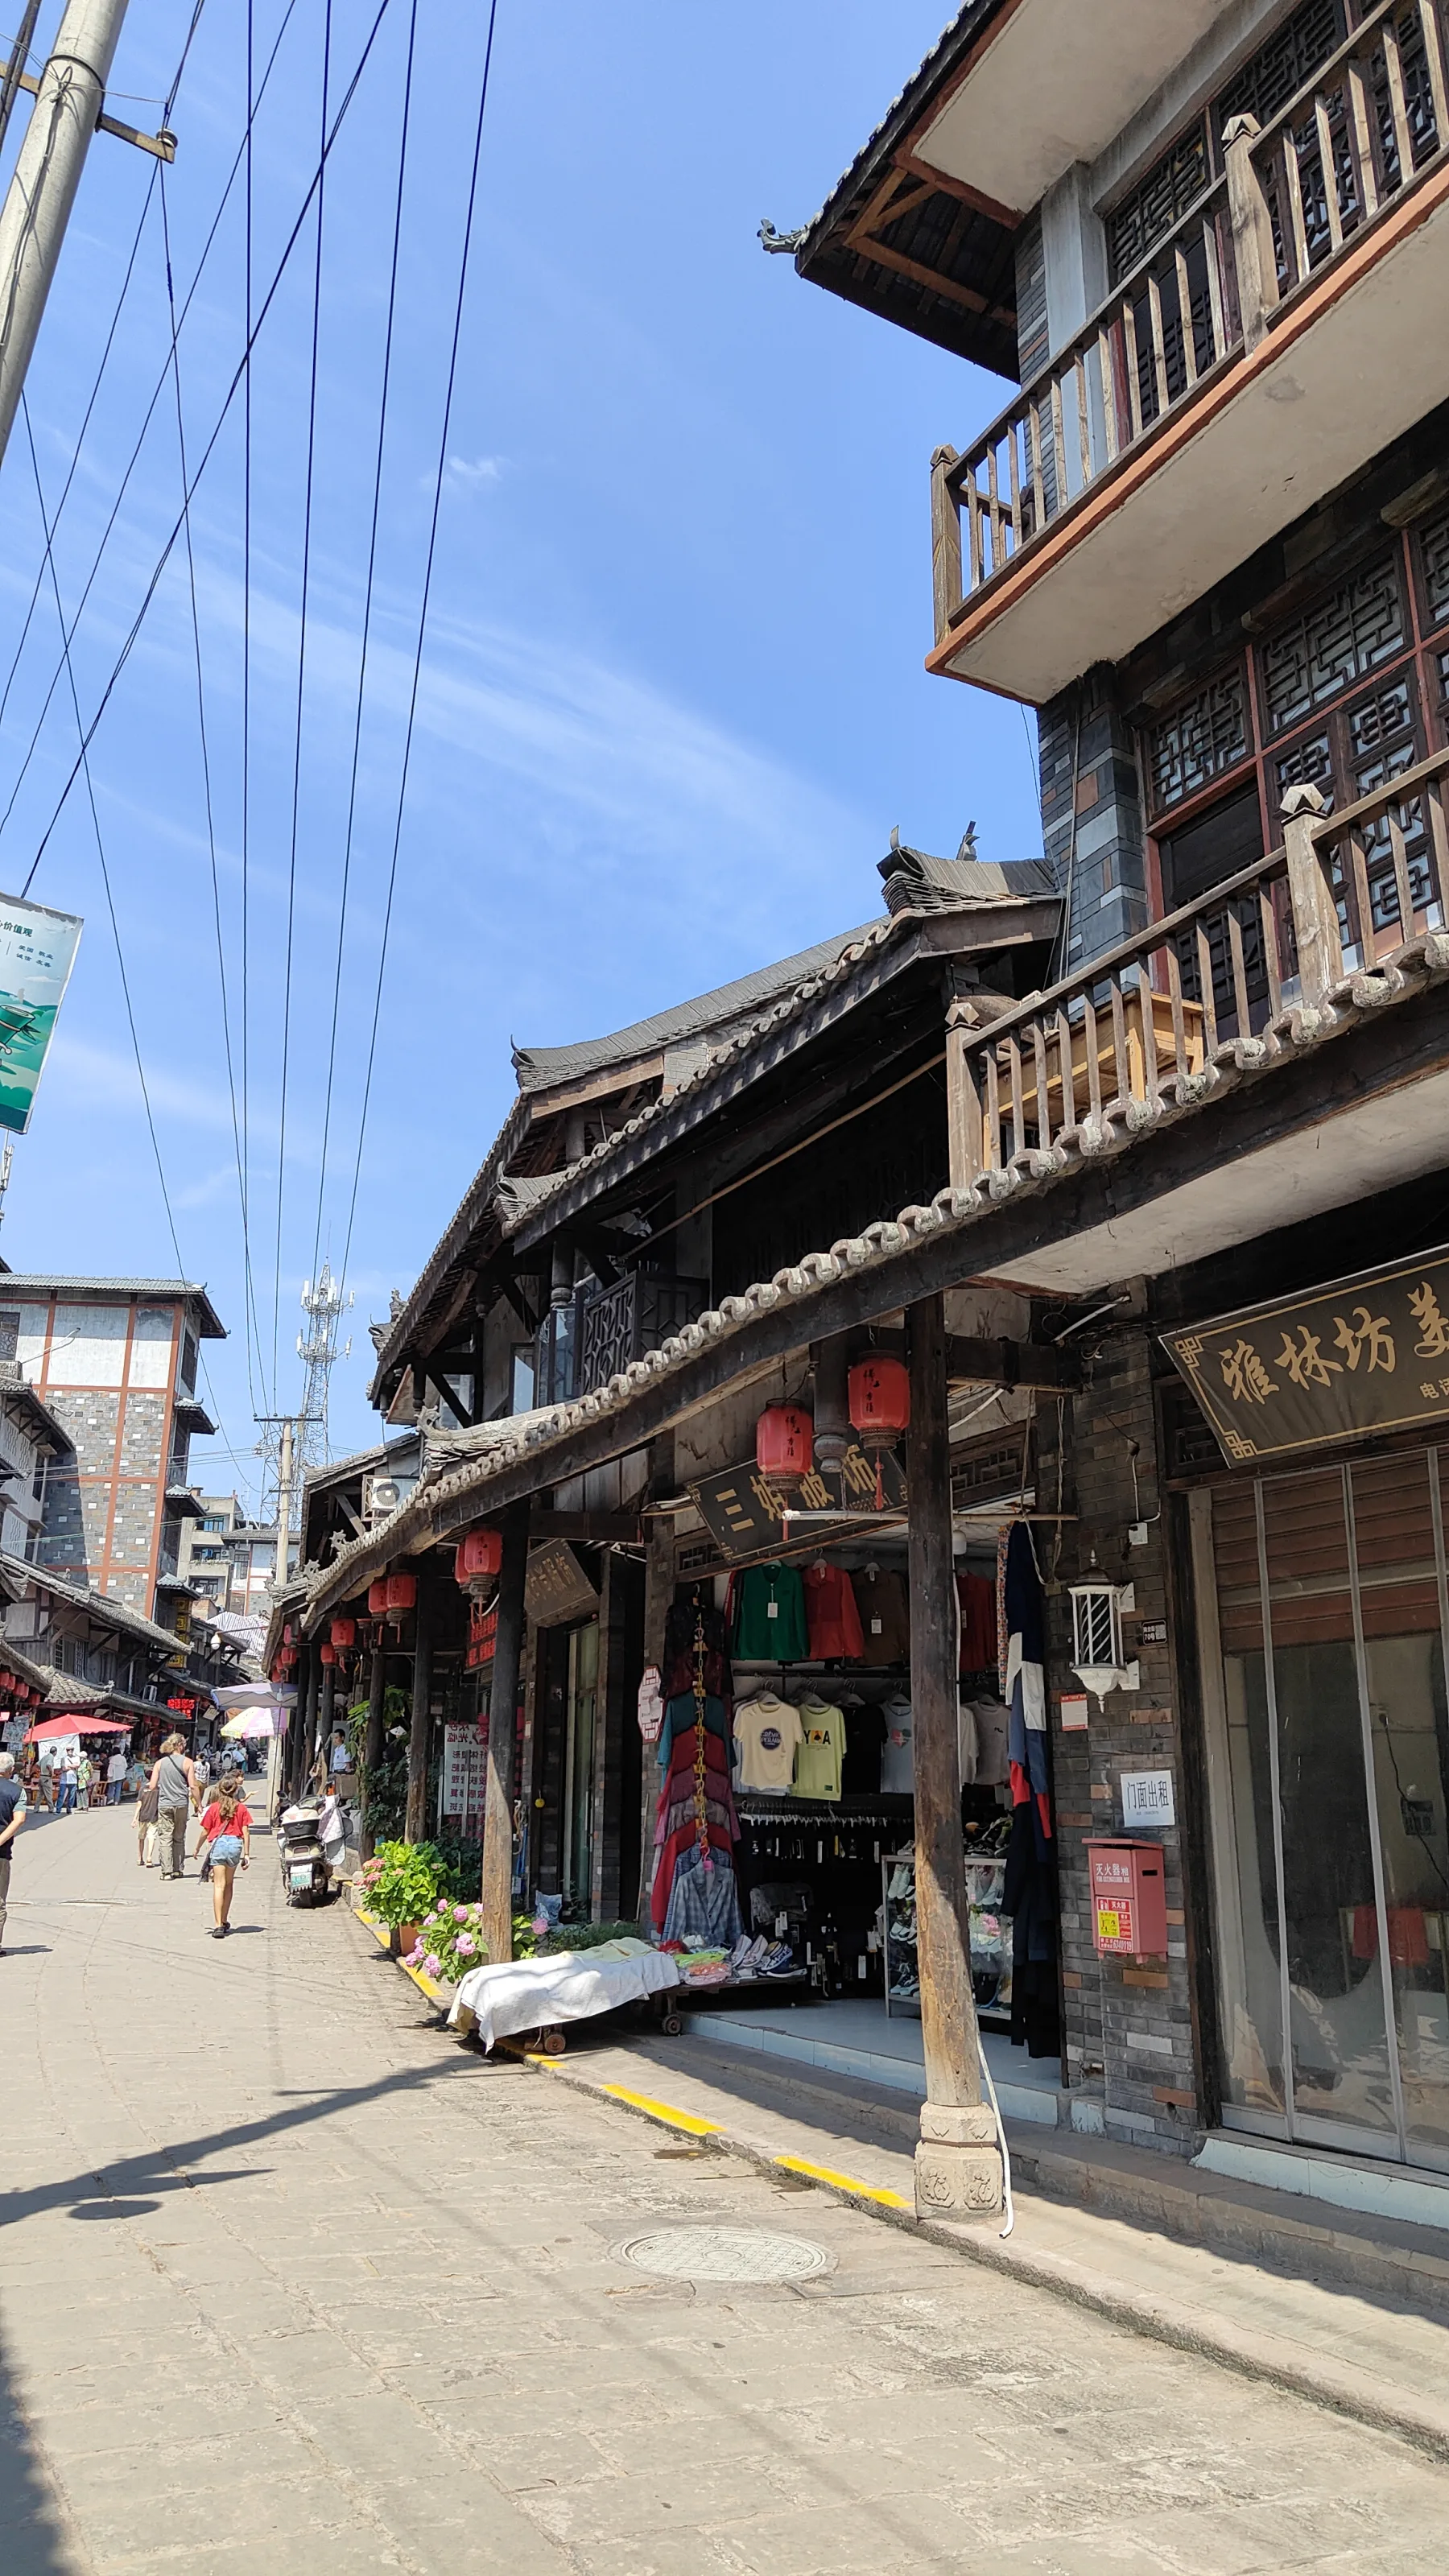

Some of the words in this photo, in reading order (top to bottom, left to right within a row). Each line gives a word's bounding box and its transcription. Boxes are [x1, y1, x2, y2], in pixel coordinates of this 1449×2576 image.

[0, 919, 33, 938] 价值观
[1127, 1780, 1169, 1810] 门面出租
